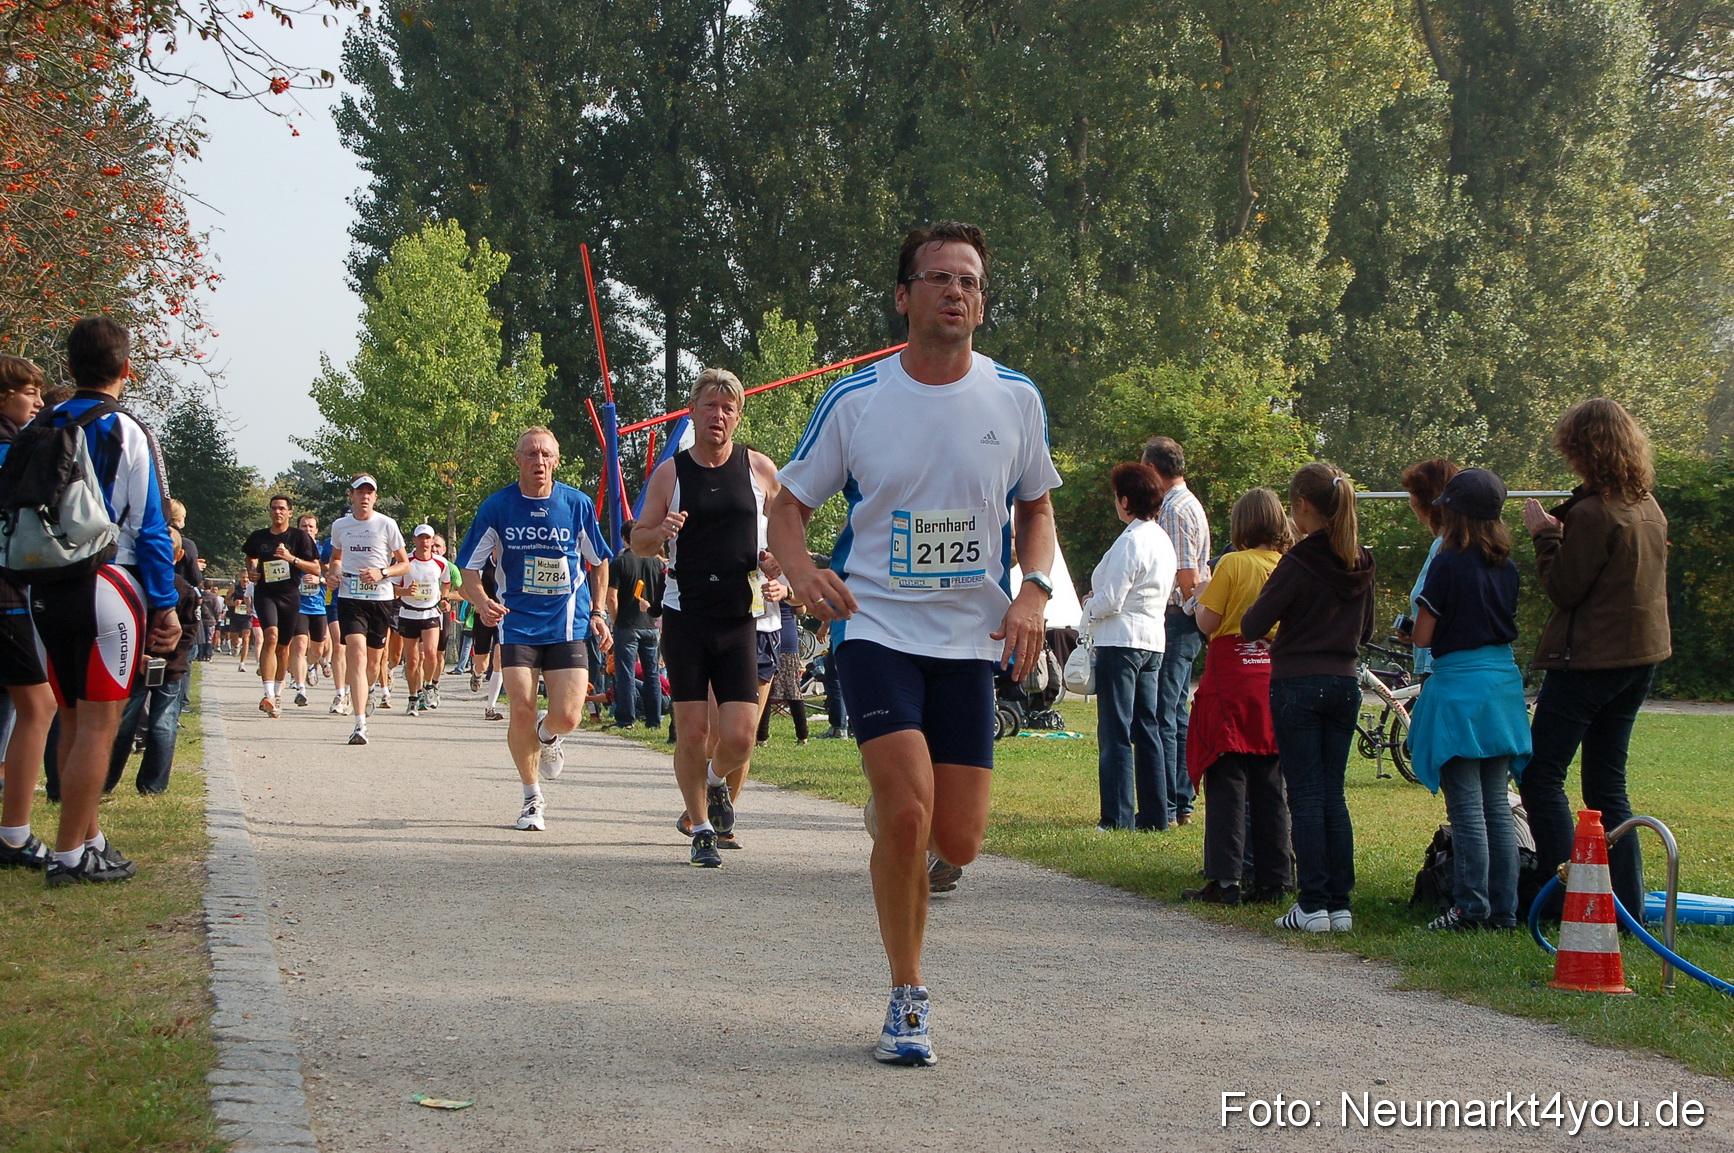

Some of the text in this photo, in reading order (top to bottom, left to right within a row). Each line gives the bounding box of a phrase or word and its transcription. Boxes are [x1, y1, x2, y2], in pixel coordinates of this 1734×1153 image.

[915, 515, 976, 534] Bernhard
[505, 526, 571, 542] SYSCAD
[893, 540, 900, 552] C
[916, 540, 981, 565] 2125
[537, 560, 560, 569] Michael
[272, 567, 286, 575] 412
[537, 571, 567, 582] 2784
[359, 583, 378, 591] 3047
